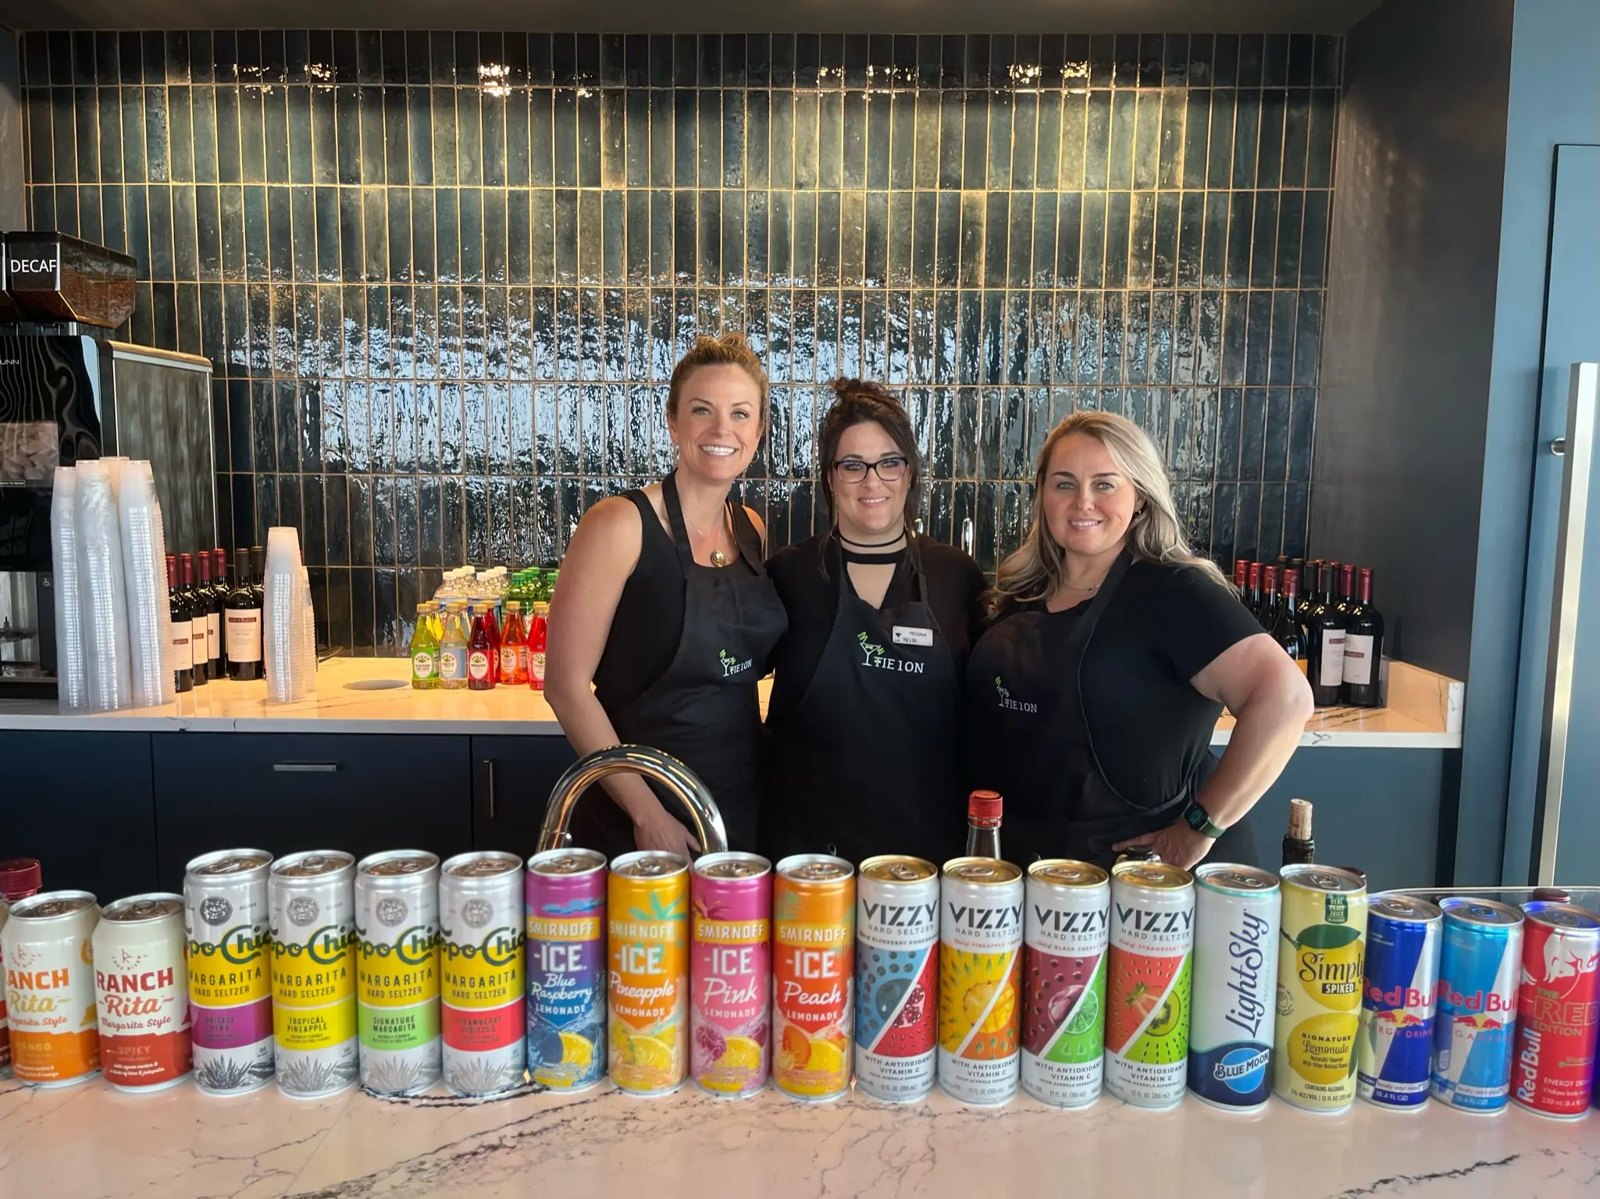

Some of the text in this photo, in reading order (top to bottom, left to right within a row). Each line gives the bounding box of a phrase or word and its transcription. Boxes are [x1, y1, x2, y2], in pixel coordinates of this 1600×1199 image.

[11, 259, 57, 273] DECAF
[862, 898, 938, 926] VIZZY
[949, 901, 1023, 930] VIZZY
[1034, 904, 1110, 932] VIZZY
[1115, 902, 1194, 933] VIZZY
[528, 920, 594, 936] SMIRNOFF
[610, 920, 674, 938] SMIRNOFF
[698, 923, 764, 939] SMIRNOFF
[780, 926, 846, 942] SMIRNOFF
[868, 924, 892, 935] HARD
[956, 927, 980, 938] HARD
[1040, 930, 1066, 940] HARD
[1122, 928, 1148, 940] HARD
[7, 967, 70, 990] ANCH
[96, 966, 174, 994] RANCH
[273, 967, 346, 986] MARGARITA
[360, 968, 432, 987] MARGARITA
[444, 969, 516, 988] MARGARITA
[544, 972, 576, 988] Blue
[214, 984, 250, 998] SELTZER
[300, 986, 336, 998] SELTZER
[389, 986, 422, 998] SELTZER
[474, 988, 506, 1000] SELTZER
[532, 982, 593, 1004] Raspberry
[610, 971, 674, 1006] Pineapple
[704, 976, 758, 1004] Pink
[784, 980, 842, 1005] Peach
[1325, 984, 1354, 994] SPIKED
[8, 989, 57, 1013] Rita
[104, 994, 162, 1017] Rita
[536, 1004, 586, 1015] LEMONADE
[615, 1004, 665, 1017] LEMONADE
[704, 1007, 756, 1018] LEMONADE
[787, 1008, 838, 1022] LEMONADE
[1534, 994, 1598, 1026] RED
[42, 1015, 68, 1028] Style
[101, 1015, 171, 1032] Margarita Style
[289, 1016, 325, 1025] TROPICAL
[373, 1015, 416, 1025] SIGNATURE
[373, 1022, 416, 1033] MARGARITA
[1532, 1018, 1582, 1036] EDITION
[287, 1023, 328, 1033] PINEAPPLE
[1302, 1032, 1352, 1042] SIGNATURE
[1302, 1040, 1348, 1056] Lemonade
[864, 1055, 882, 1064] WITH
[952, 1058, 970, 1068] WITH
[1034, 1061, 1054, 1070] WITH
[1114, 1058, 1133, 1070] WITH
[1214, 1051, 1269, 1079] BLUE MOON
[1516, 1027, 1542, 1104] Red Bull
[1131, 1072, 1165, 1082] VITAMIN
[1544, 1077, 1574, 1087] ENERGY
